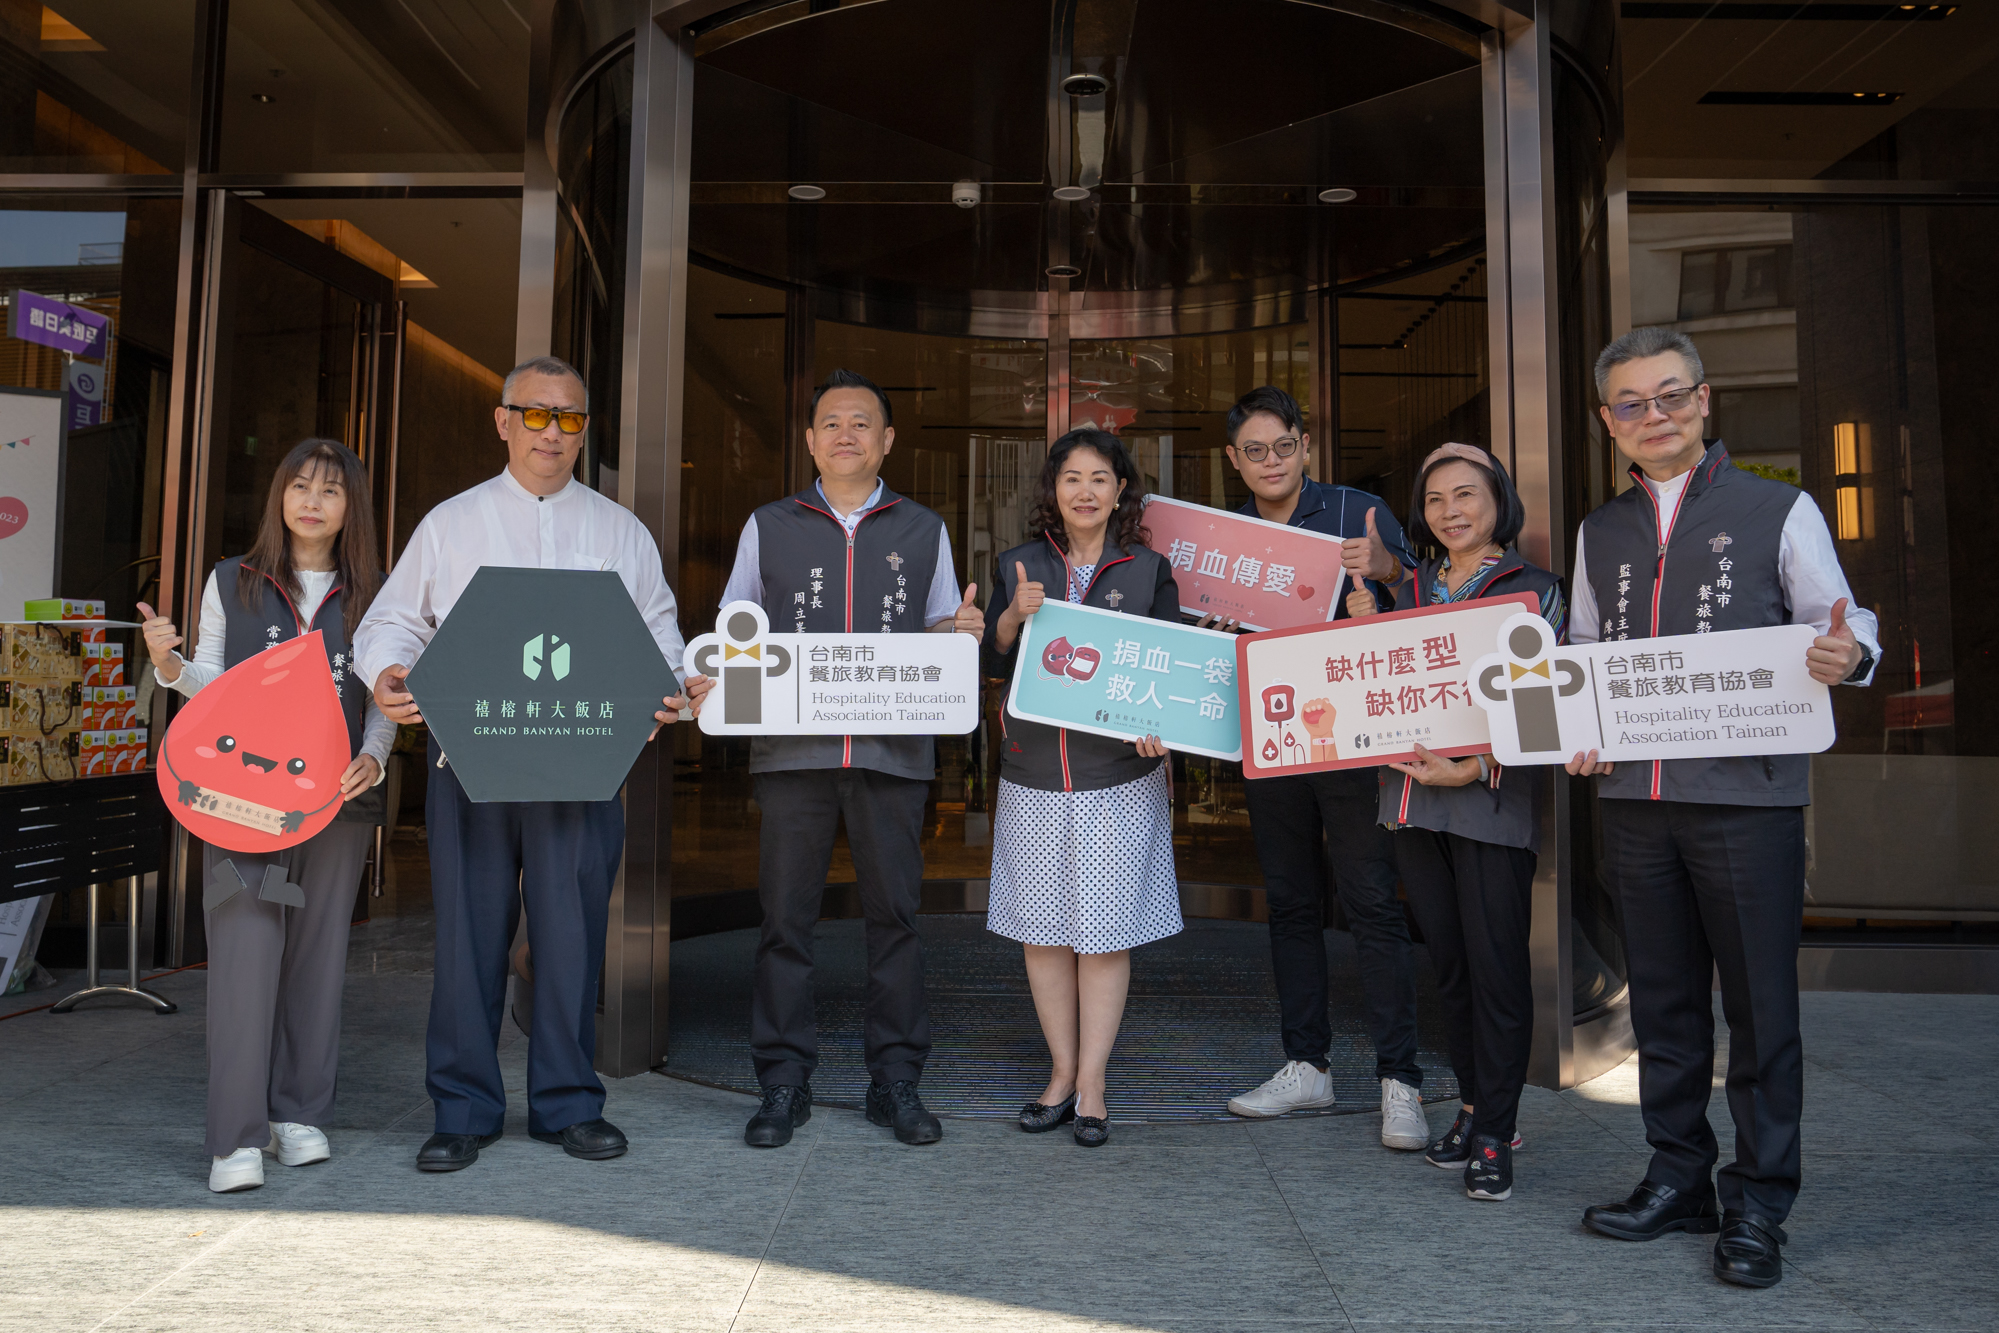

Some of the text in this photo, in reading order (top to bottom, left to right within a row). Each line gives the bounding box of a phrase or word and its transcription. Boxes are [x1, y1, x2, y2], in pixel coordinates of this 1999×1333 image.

[1168, 538, 1296, 597] 捐血傳愛
[810, 567, 823, 608] 理事長
[895, 574, 906, 615] 台南市
[1715, 557, 1733, 608] 台南市
[808, 645, 875, 662] 台南市
[1111, 639, 1233, 687] 捐血一袋
[1325, 632, 1461, 684] 缺什麼型
[1604, 650, 1684, 675] 台南市
[808, 665, 942, 682] 餐旅教育協會
[1608, 668, 1774, 700] 餐旅教育協會
[474, 700, 615, 719] 禧榕軒大飯店
[812, 692, 966, 707] Hospitality Education
[1105, 674, 1228, 721] 救人一命
[812, 709, 945, 722] Association Tainan
[1614, 701, 1814, 726] Hospitality Education
[473, 727, 614, 736] GRAND BANYAN HOTEL
[1619, 723, 1788, 745] Association Tainan
